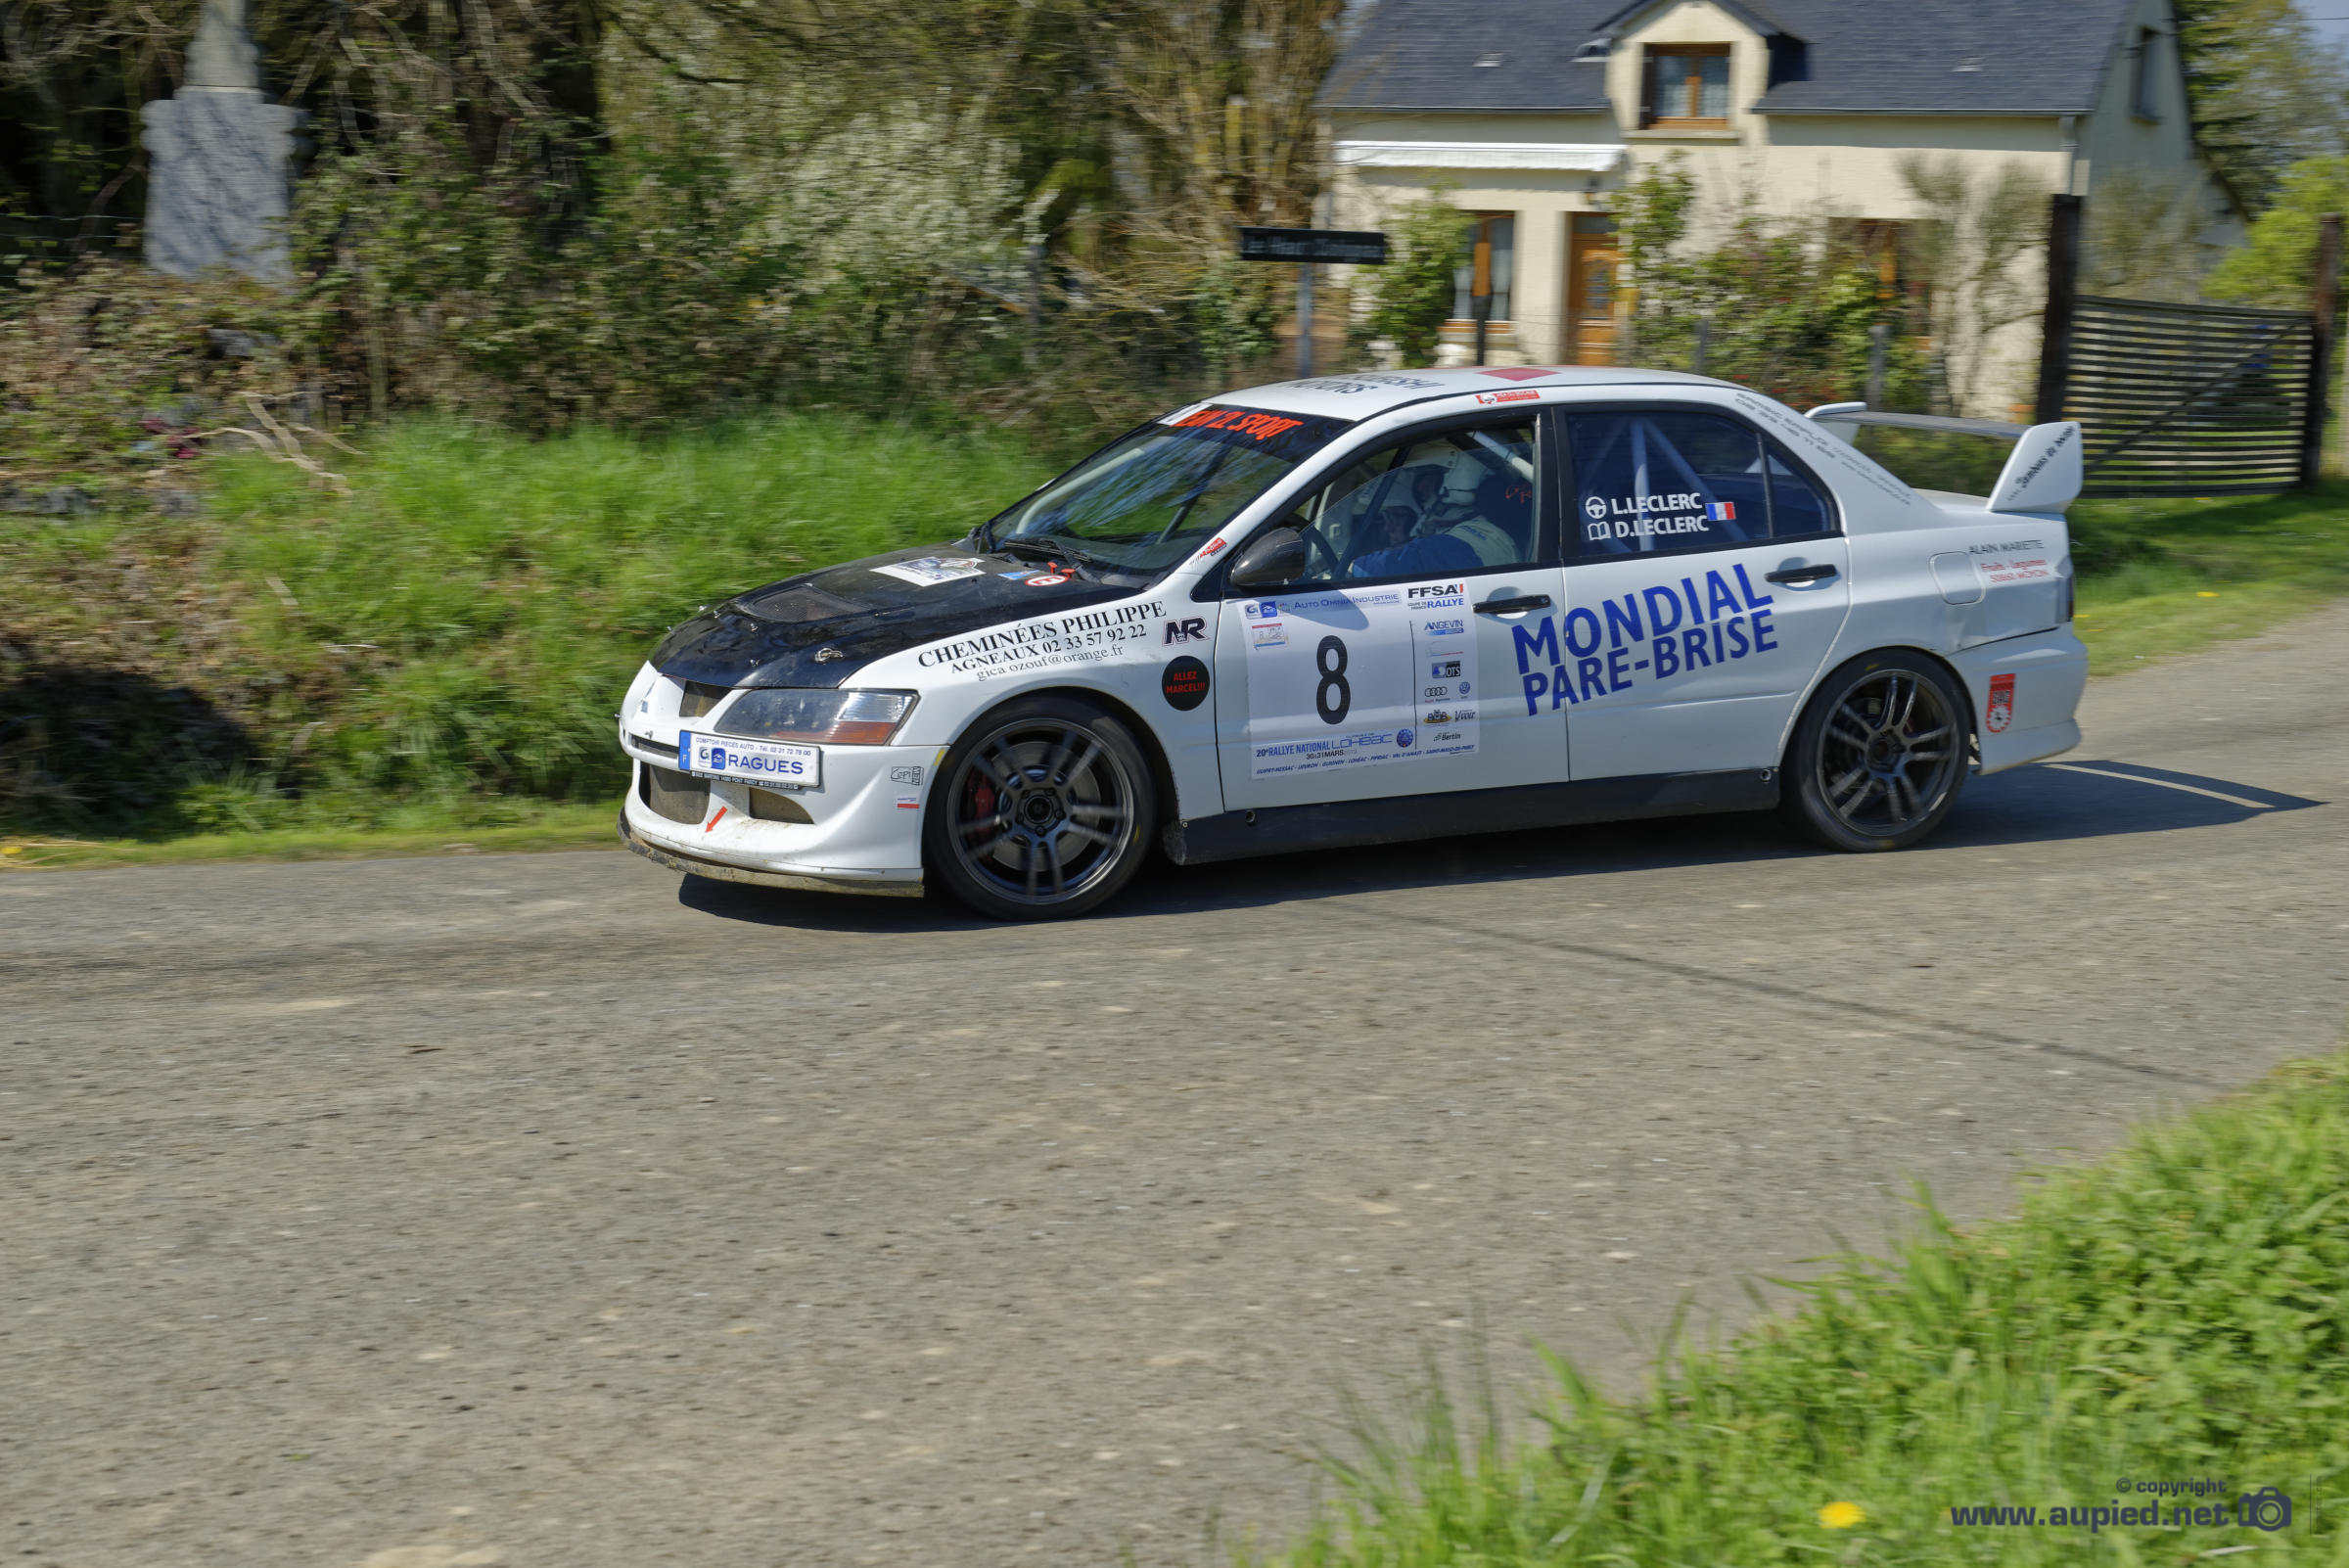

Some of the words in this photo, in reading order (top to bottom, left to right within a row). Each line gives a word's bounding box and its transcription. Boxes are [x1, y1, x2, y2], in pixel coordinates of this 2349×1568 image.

[1226, 413, 1305, 440] SPORT
[1611, 492, 1703, 515] L.LECLERC
[1615, 515, 1710, 538] D.LECLERC
[1294, 601, 1319, 610] AUTO
[1321, 598, 1352, 607] OMNIA
[1352, 593, 1399, 603] INDUSTRIE
[1408, 585, 1458, 598] FFSA
[1427, 598, 1464, 609] RALLYE
[1424, 619, 1464, 630] ANGEVIN
[1511, 563, 1774, 675] MONDIAL
[918, 621, 1057, 668] CHEMINÉES
[1061, 600, 1167, 634] PHILIPPE
[951, 645, 1038, 674] AGNEAUX
[1042, 639, 1061, 654] 02
[1066, 636, 1082, 650] 33
[1087, 631, 1103, 646] 57
[1107, 628, 1126, 642] 92
[1128, 623, 1146, 637] 22
[1522, 609, 1778, 716] PARE-BRISE
[1174, 670, 1197, 681] ALLEZ
[1315, 635, 1352, 724] 8
[1166, 682, 1205, 694] MARCEL!!!
[695, 737, 720, 746] COMPTOIR
[739, 742, 755, 751] AUTO
[1268, 745, 1294, 757] RALLYE
[1296, 740, 1330, 753] NATIONAL
[728, 754, 804, 775] RAGUES
